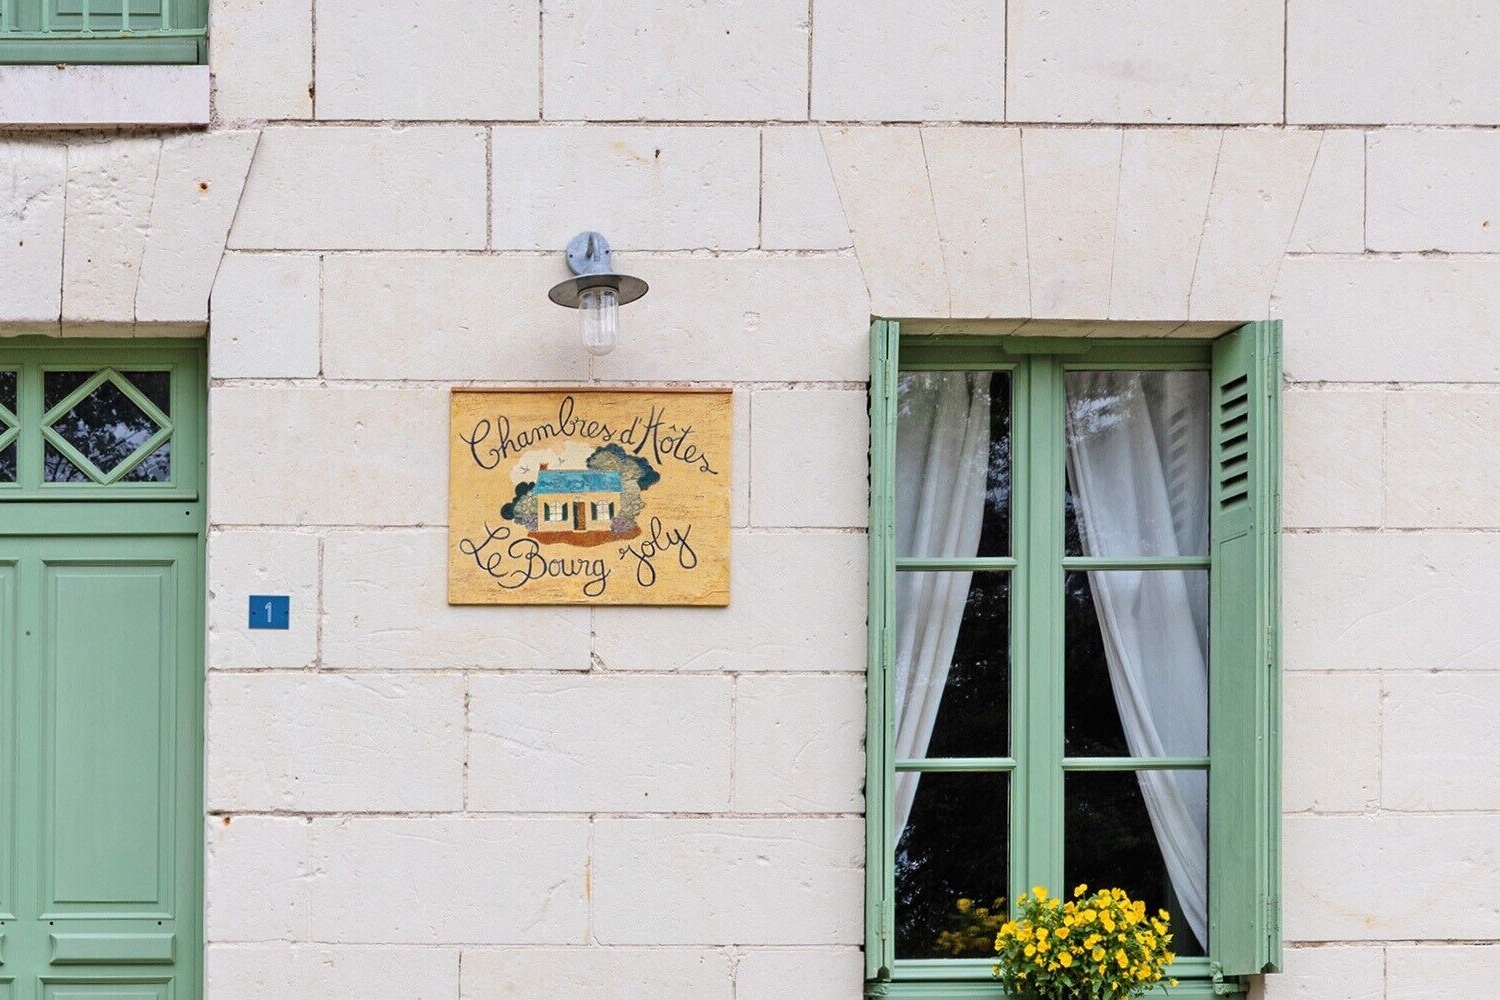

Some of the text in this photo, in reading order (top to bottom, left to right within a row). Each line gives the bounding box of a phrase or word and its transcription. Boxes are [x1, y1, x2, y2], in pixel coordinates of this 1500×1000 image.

[459, 395, 718, 475] Chambres d'Hôtes
[459, 521, 511, 578] Le
[497, 538, 611, 597] Bourg
[264, 601, 272, 623] 1
